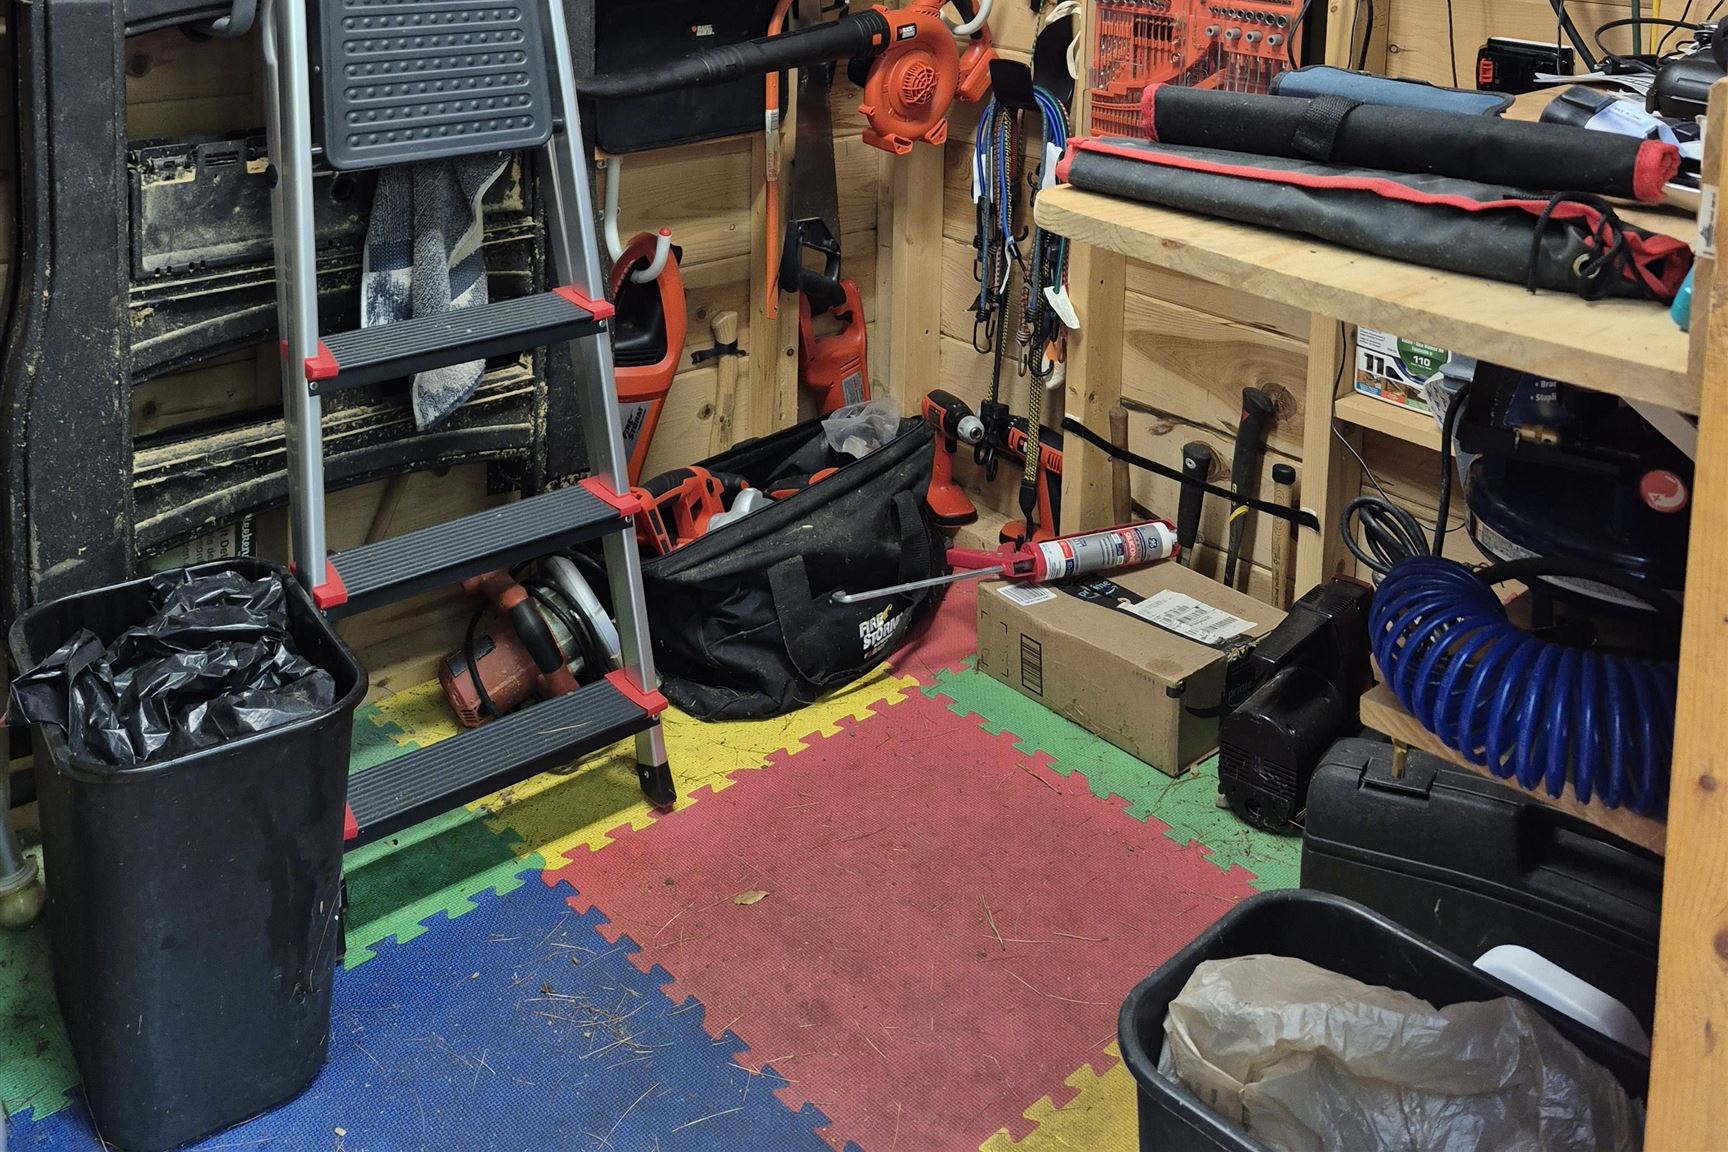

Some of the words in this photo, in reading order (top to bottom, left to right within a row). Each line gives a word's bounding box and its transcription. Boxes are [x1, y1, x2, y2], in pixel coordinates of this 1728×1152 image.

[1413, 355, 1431, 367] 110
[628, 406, 644, 440] STORM
[859, 611, 884, 639] FIRE
[863, 612, 904, 650] STORM
